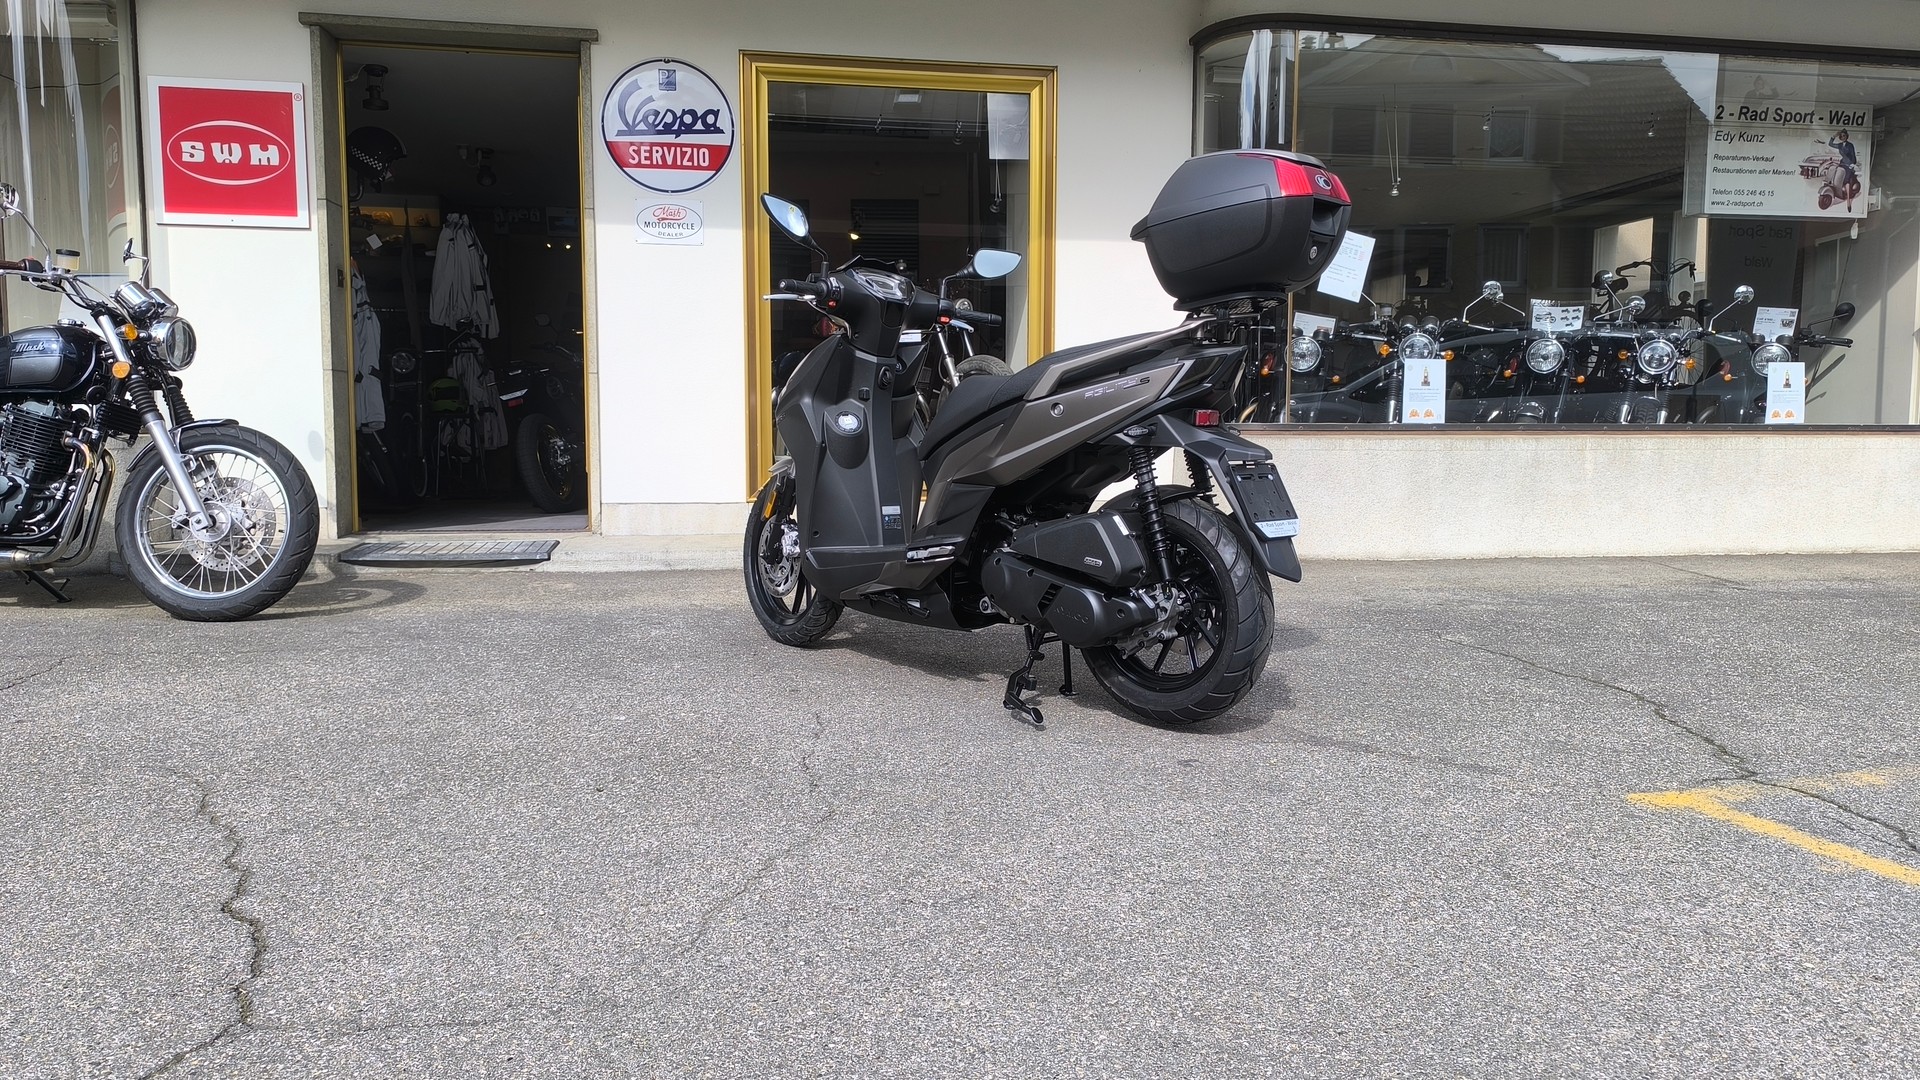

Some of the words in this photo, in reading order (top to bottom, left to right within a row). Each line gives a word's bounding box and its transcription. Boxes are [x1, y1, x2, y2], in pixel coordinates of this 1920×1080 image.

[615, 78, 726, 140] Vespa
[1715, 104, 1725, 120] 2
[1737, 106, 1769, 122] Rad
[1773, 107, 1815, 126] Sport
[1829, 110, 1866, 126] Wald
[1714, 130, 1735, 144] Edy
[1737, 131, 1765, 143] Kunz
[180, 141, 280, 166] SWM
[628, 145, 710, 167] SERVIZIO
[1713, 153, 1775, 163] Reparaturen-Verkauf
[1712, 166, 1757, 175] Restaurationen
[1758, 168, 1771, 176] aller
[1712, 188, 1733, 196] Telefon
[1734, 188, 1745, 197] 055
[1758, 189, 1766, 198] 45
[1767, 190, 1775, 198] 15
[1711, 200, 1764, 208] www.2-radsport.ch
[652, 205, 688, 222] Mash
[643, 221, 695, 231] MOTORCYCLE
